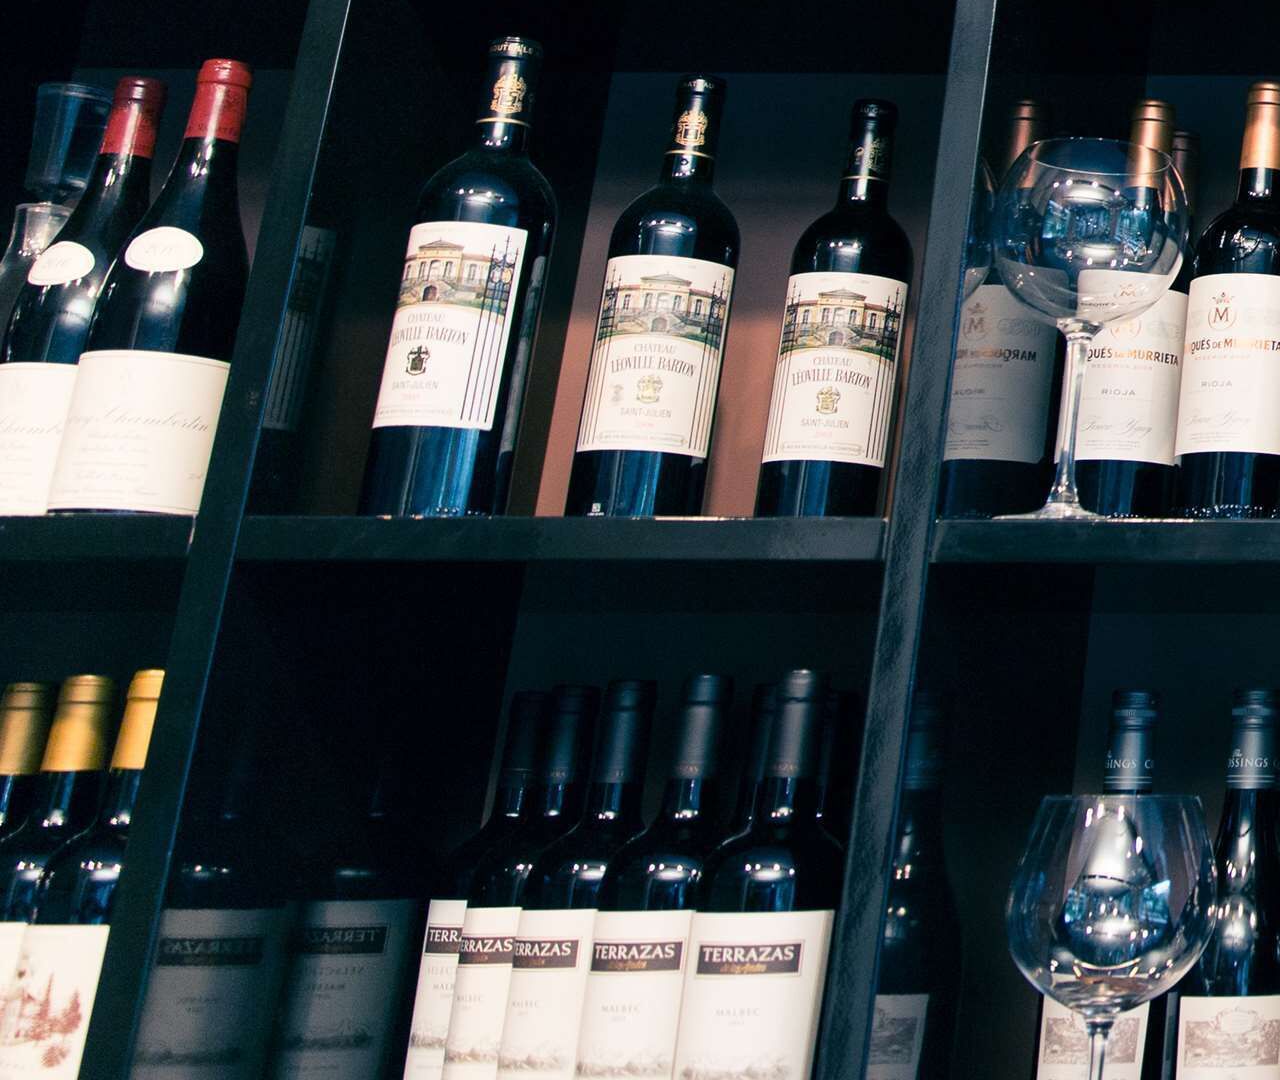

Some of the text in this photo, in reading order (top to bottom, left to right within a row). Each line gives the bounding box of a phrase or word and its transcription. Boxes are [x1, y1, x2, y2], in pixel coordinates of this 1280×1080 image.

[658, 355, 697, 378] BARTON
[1127, 350, 1180, 367] MURRIETA
[835, 369, 873, 390] BARTON
[1100, 388, 1136, 396] RIOJA
[594, 943, 676, 960] TERRAZAS
[703, 946, 795, 963] TERRAZAS
